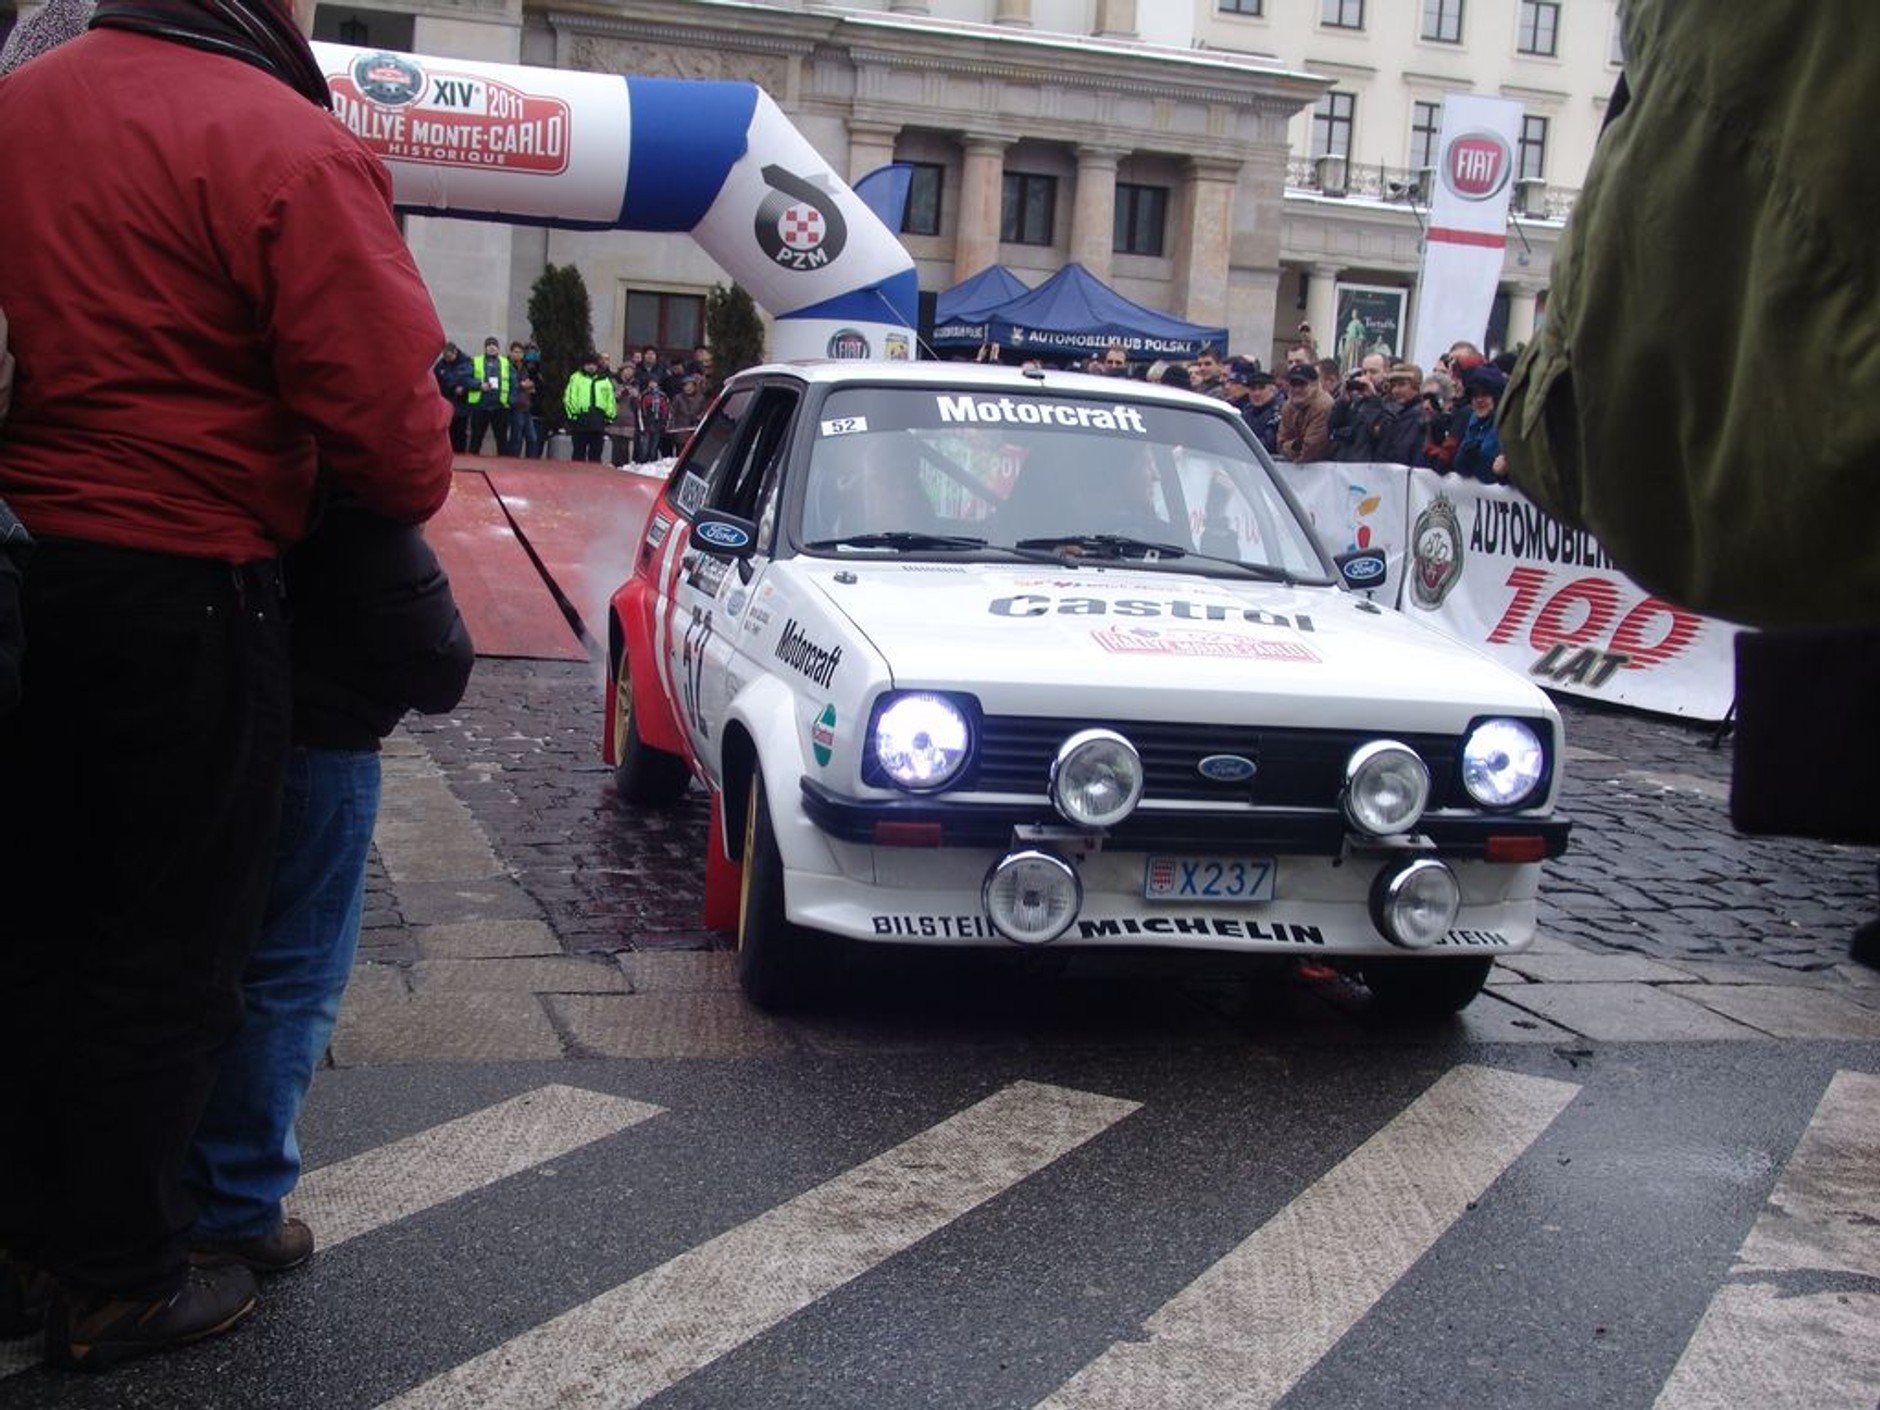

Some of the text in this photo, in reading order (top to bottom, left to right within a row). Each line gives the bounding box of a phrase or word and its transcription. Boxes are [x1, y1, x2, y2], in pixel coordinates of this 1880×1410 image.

[331, 90, 406, 142] RALLYE
[488, 85, 523, 119] 2011
[388, 143, 506, 165] HISTORIQUE
[1456, 147, 1499, 183] FIAT
[776, 246, 829, 269] PZM
[831, 418, 857, 434] 52
[936, 396, 1148, 433] Motorcraft
[705, 525, 739, 544] Ford
[1470, 497, 1617, 570] AUTOMOBIL
[988, 594, 1315, 633] Castrol
[1486, 566, 1706, 671] 100
[774, 617, 843, 690] Motorcraft
[1530, 643, 1636, 689] LAT
[1179, 861, 1271, 896] X237
[1077, 917, 1325, 945] MICHELIN
